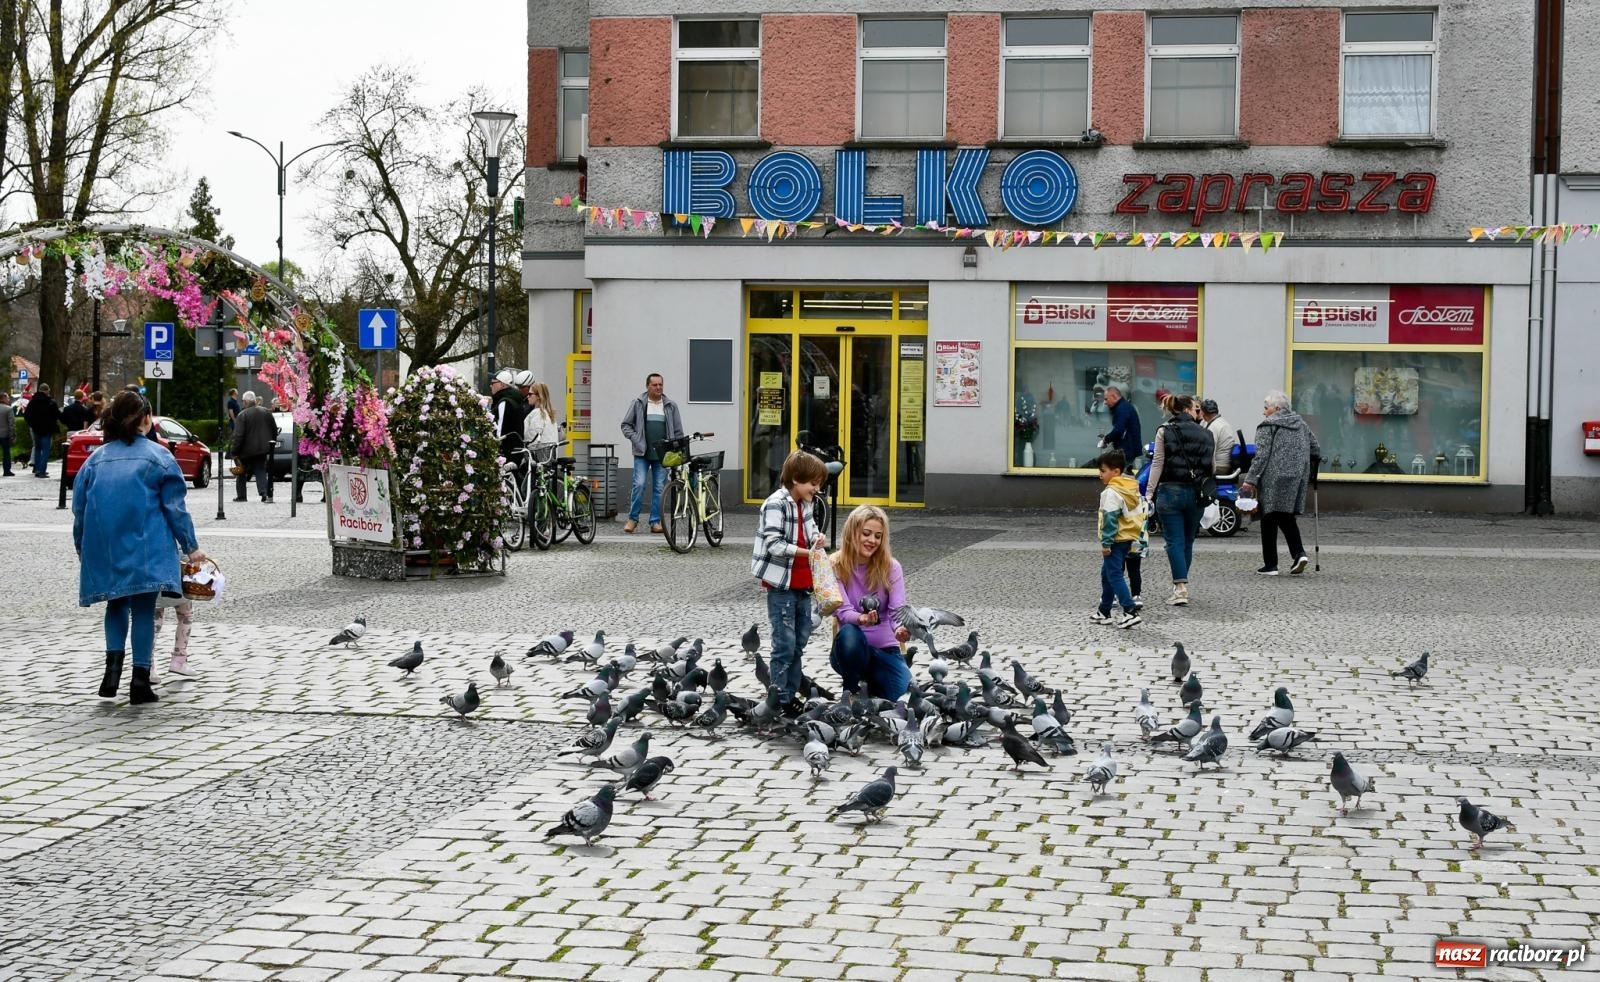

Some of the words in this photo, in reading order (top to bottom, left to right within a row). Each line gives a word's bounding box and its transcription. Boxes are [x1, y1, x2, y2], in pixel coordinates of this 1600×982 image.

[663, 149, 1079, 227] BOLKO
[1115, 172, 1438, 226] zaprasza
[1045, 304, 1096, 320] Bliski
[1325, 305, 1377, 321] Bliski
[151, 326, 168, 349] P
[20, 370, 27, 378] P
[340, 515, 383, 533] Racibórz
